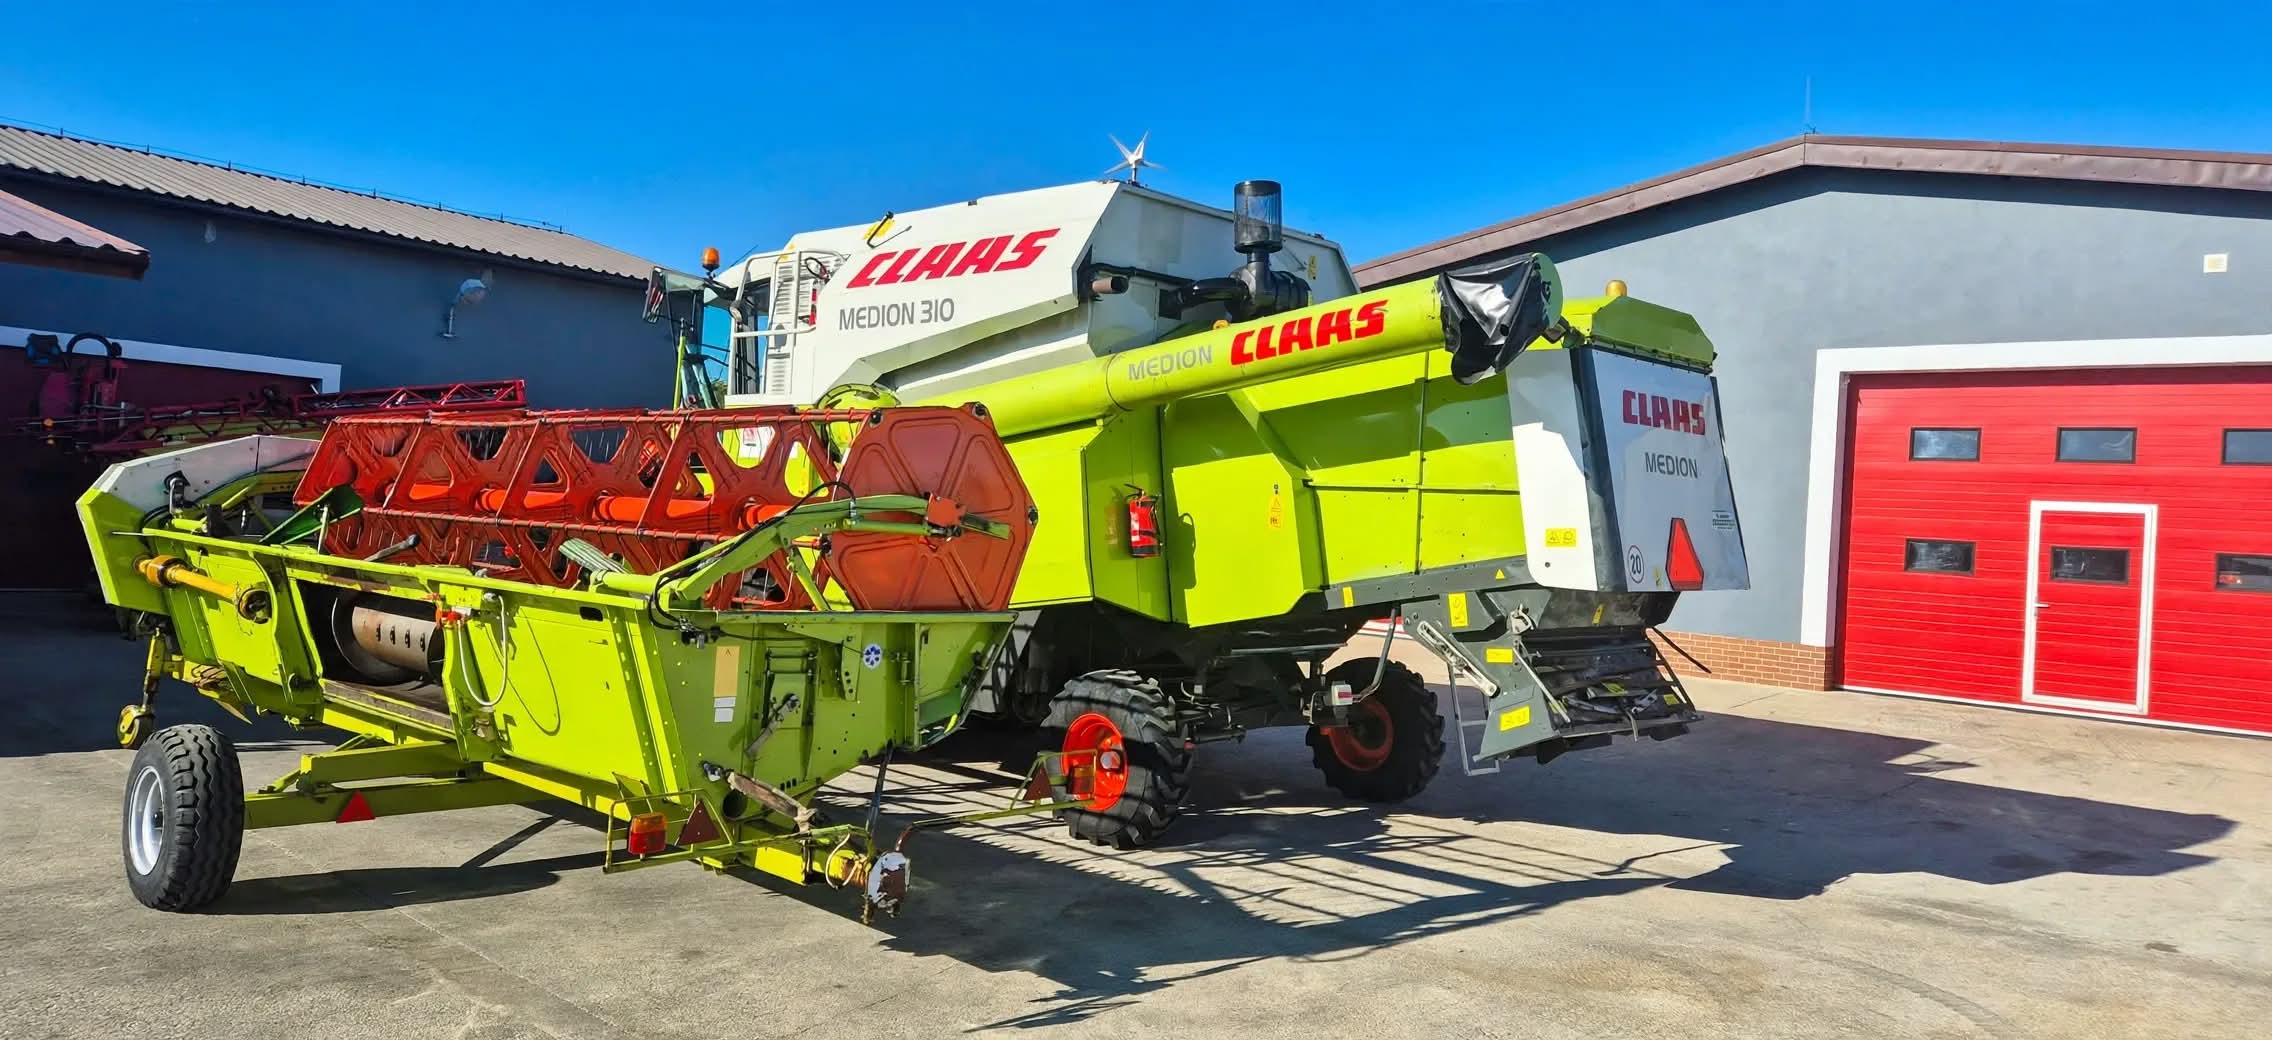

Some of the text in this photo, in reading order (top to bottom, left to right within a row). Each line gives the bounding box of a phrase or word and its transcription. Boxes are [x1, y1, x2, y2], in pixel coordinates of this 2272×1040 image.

[846, 228, 1060, 288] CLAAS
[839, 298, 955, 330] MEDION 310
[1128, 300, 1388, 381] MEDION CLAAS
[1623, 390, 1705, 435] CLAAS
[1645, 452, 1698, 478] MEDION
[1631, 554, 1642, 574] 20
